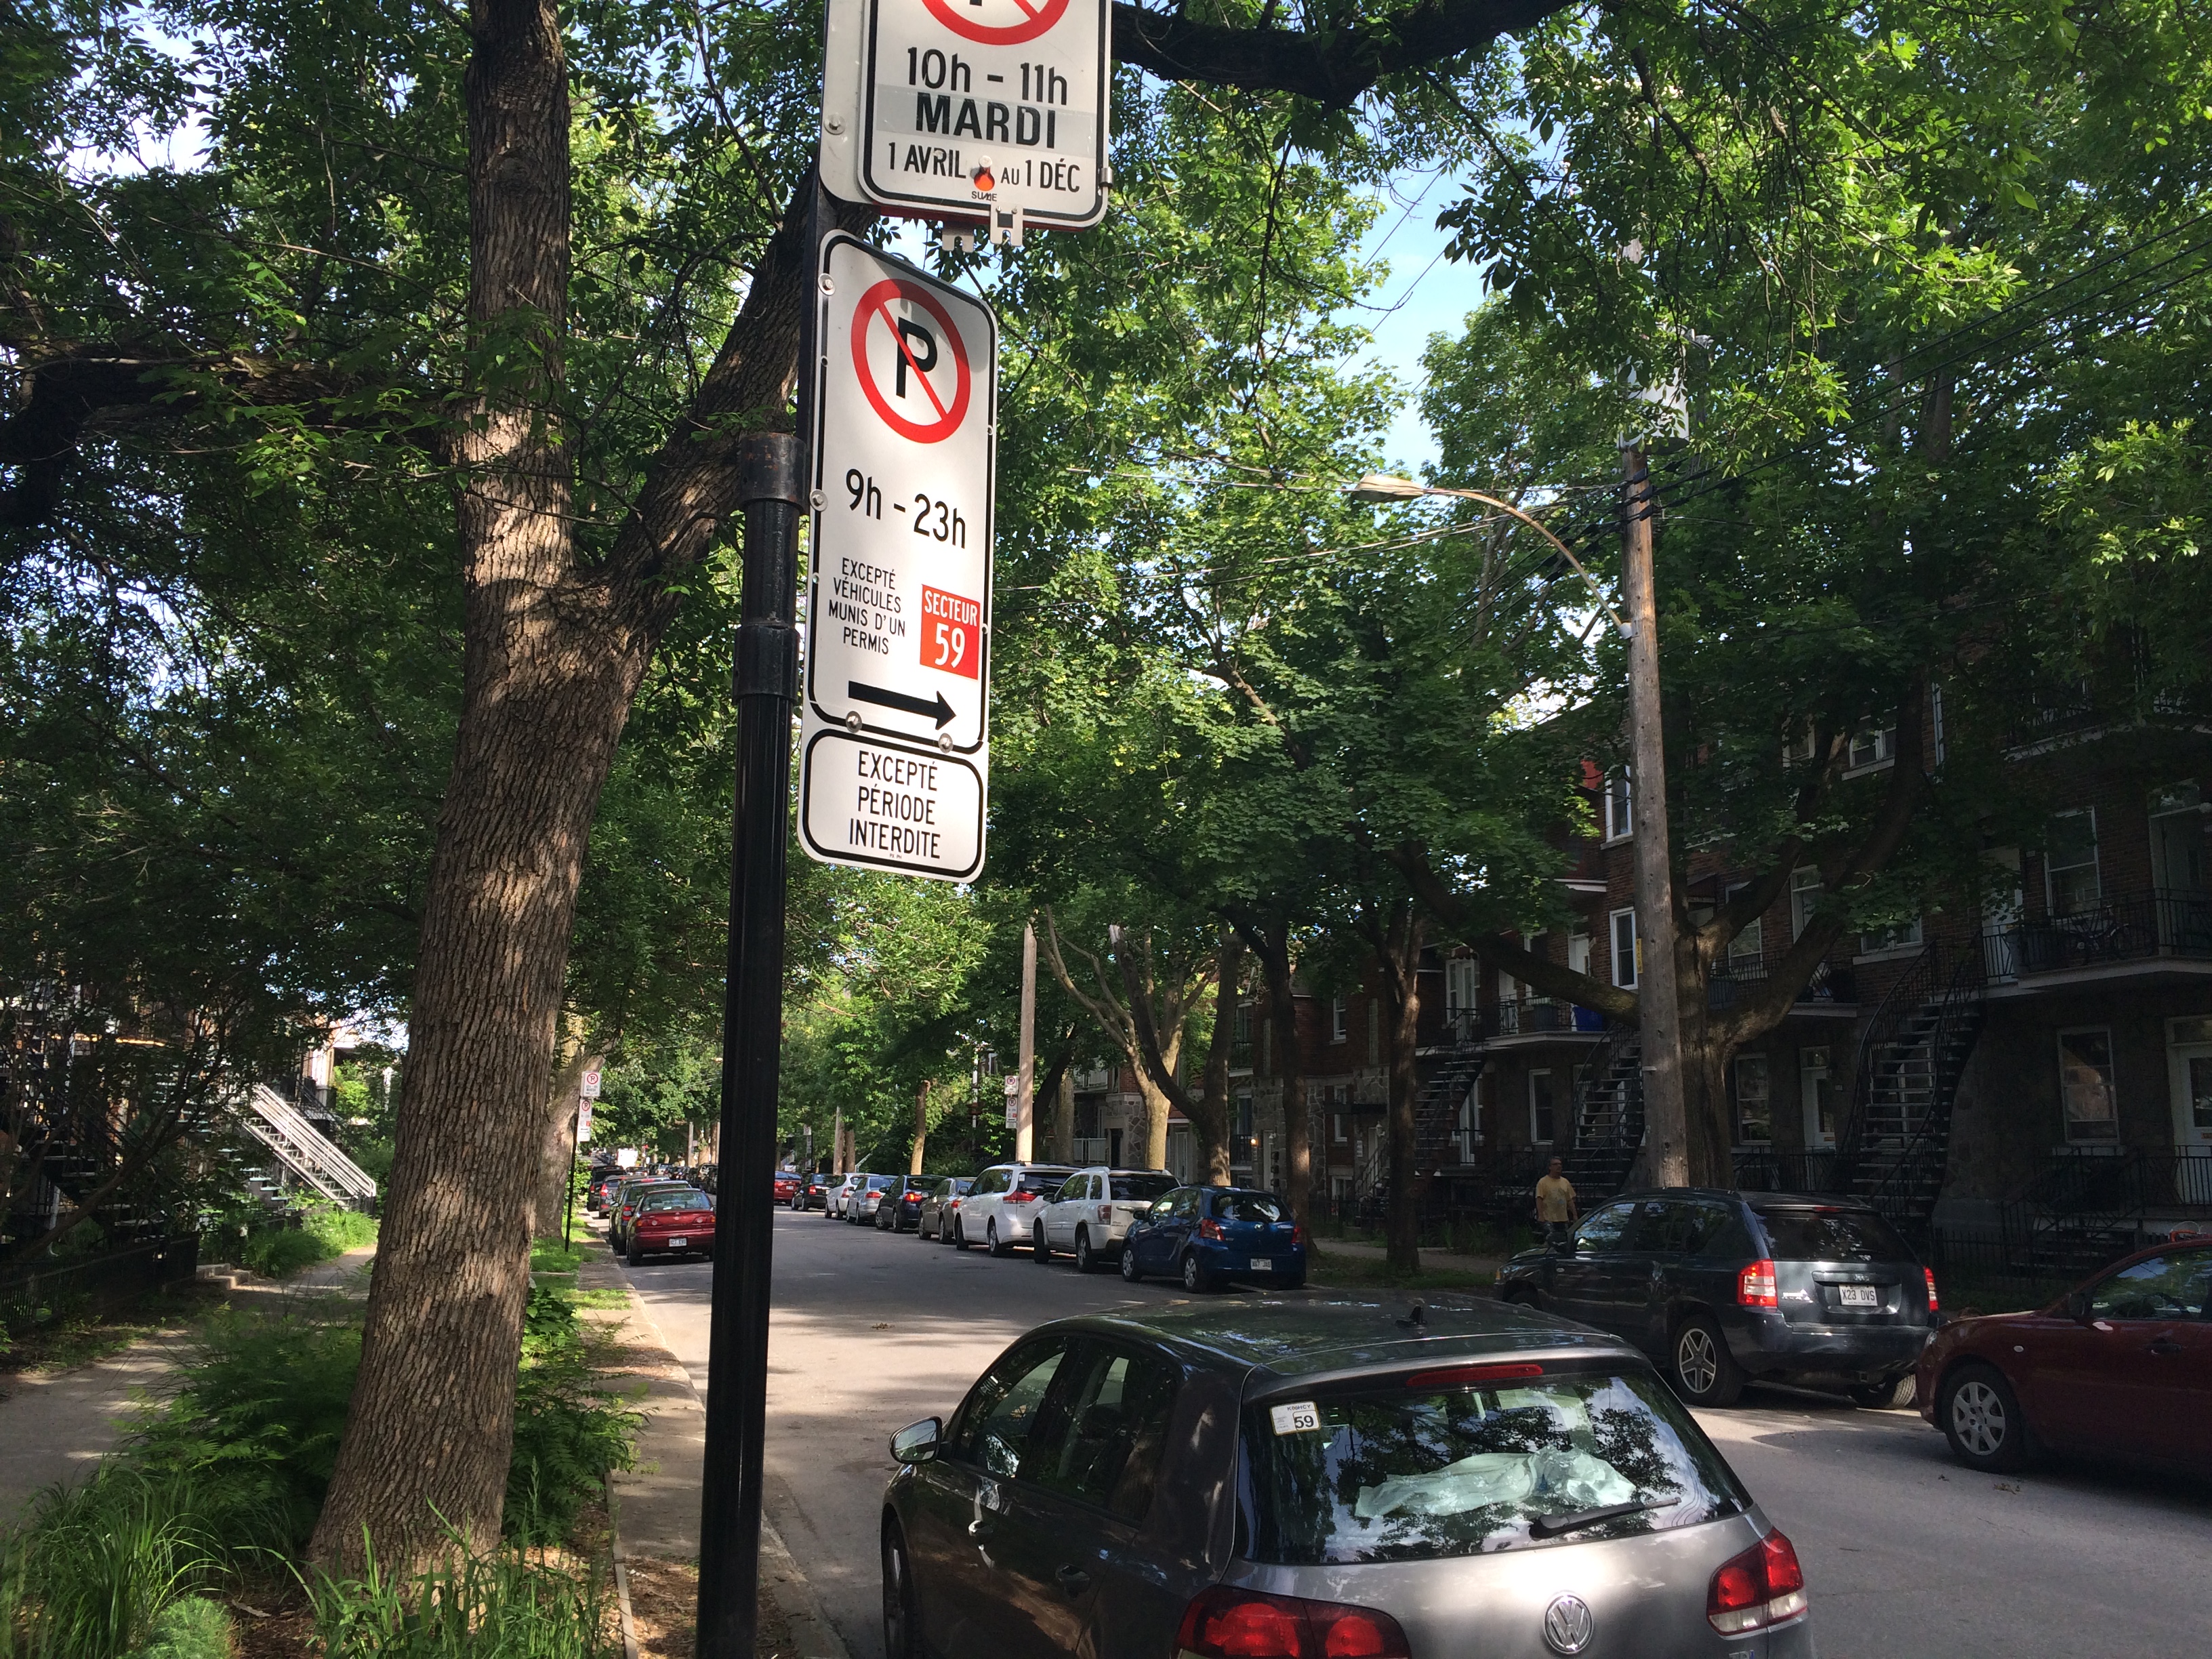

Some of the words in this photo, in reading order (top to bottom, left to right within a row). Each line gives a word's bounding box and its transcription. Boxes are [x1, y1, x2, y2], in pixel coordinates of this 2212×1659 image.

[907, 47, 970, 93] 10h
[987, 74, 1003, 83] -
[1020, 62, 1067, 105] 11h
[916, 92, 1055, 148] MARDI
[888, 142, 895, 170] 1
[904, 144, 966, 179] AVRIL
[1000, 169, 1019, 186] AU
[1025, 160, 1031, 187] 1
[1040, 158, 1080, 192] DÉC
[846, 468, 881, 520] 9h
[914, 493, 966, 550] 23h
[842, 557, 896, 590] EXCEPTÉ
[828, 599, 868, 627] MUNIS
[834, 576, 901, 613] VÉHICULES
[924, 589, 978, 627] SECTEUR
[843, 626, 889, 655] PERMIS
[935, 622, 965, 669] 59
[858, 750, 938, 792] EXCEPTÉ
[858, 783, 935, 825] PÉRIODE
[849, 819, 941, 859] INTERDITE
[1842, 1290, 1857, 1300] X23
[1860, 1290, 1875, 1301] DVS
[1294, 1415, 1314, 1429] 59
